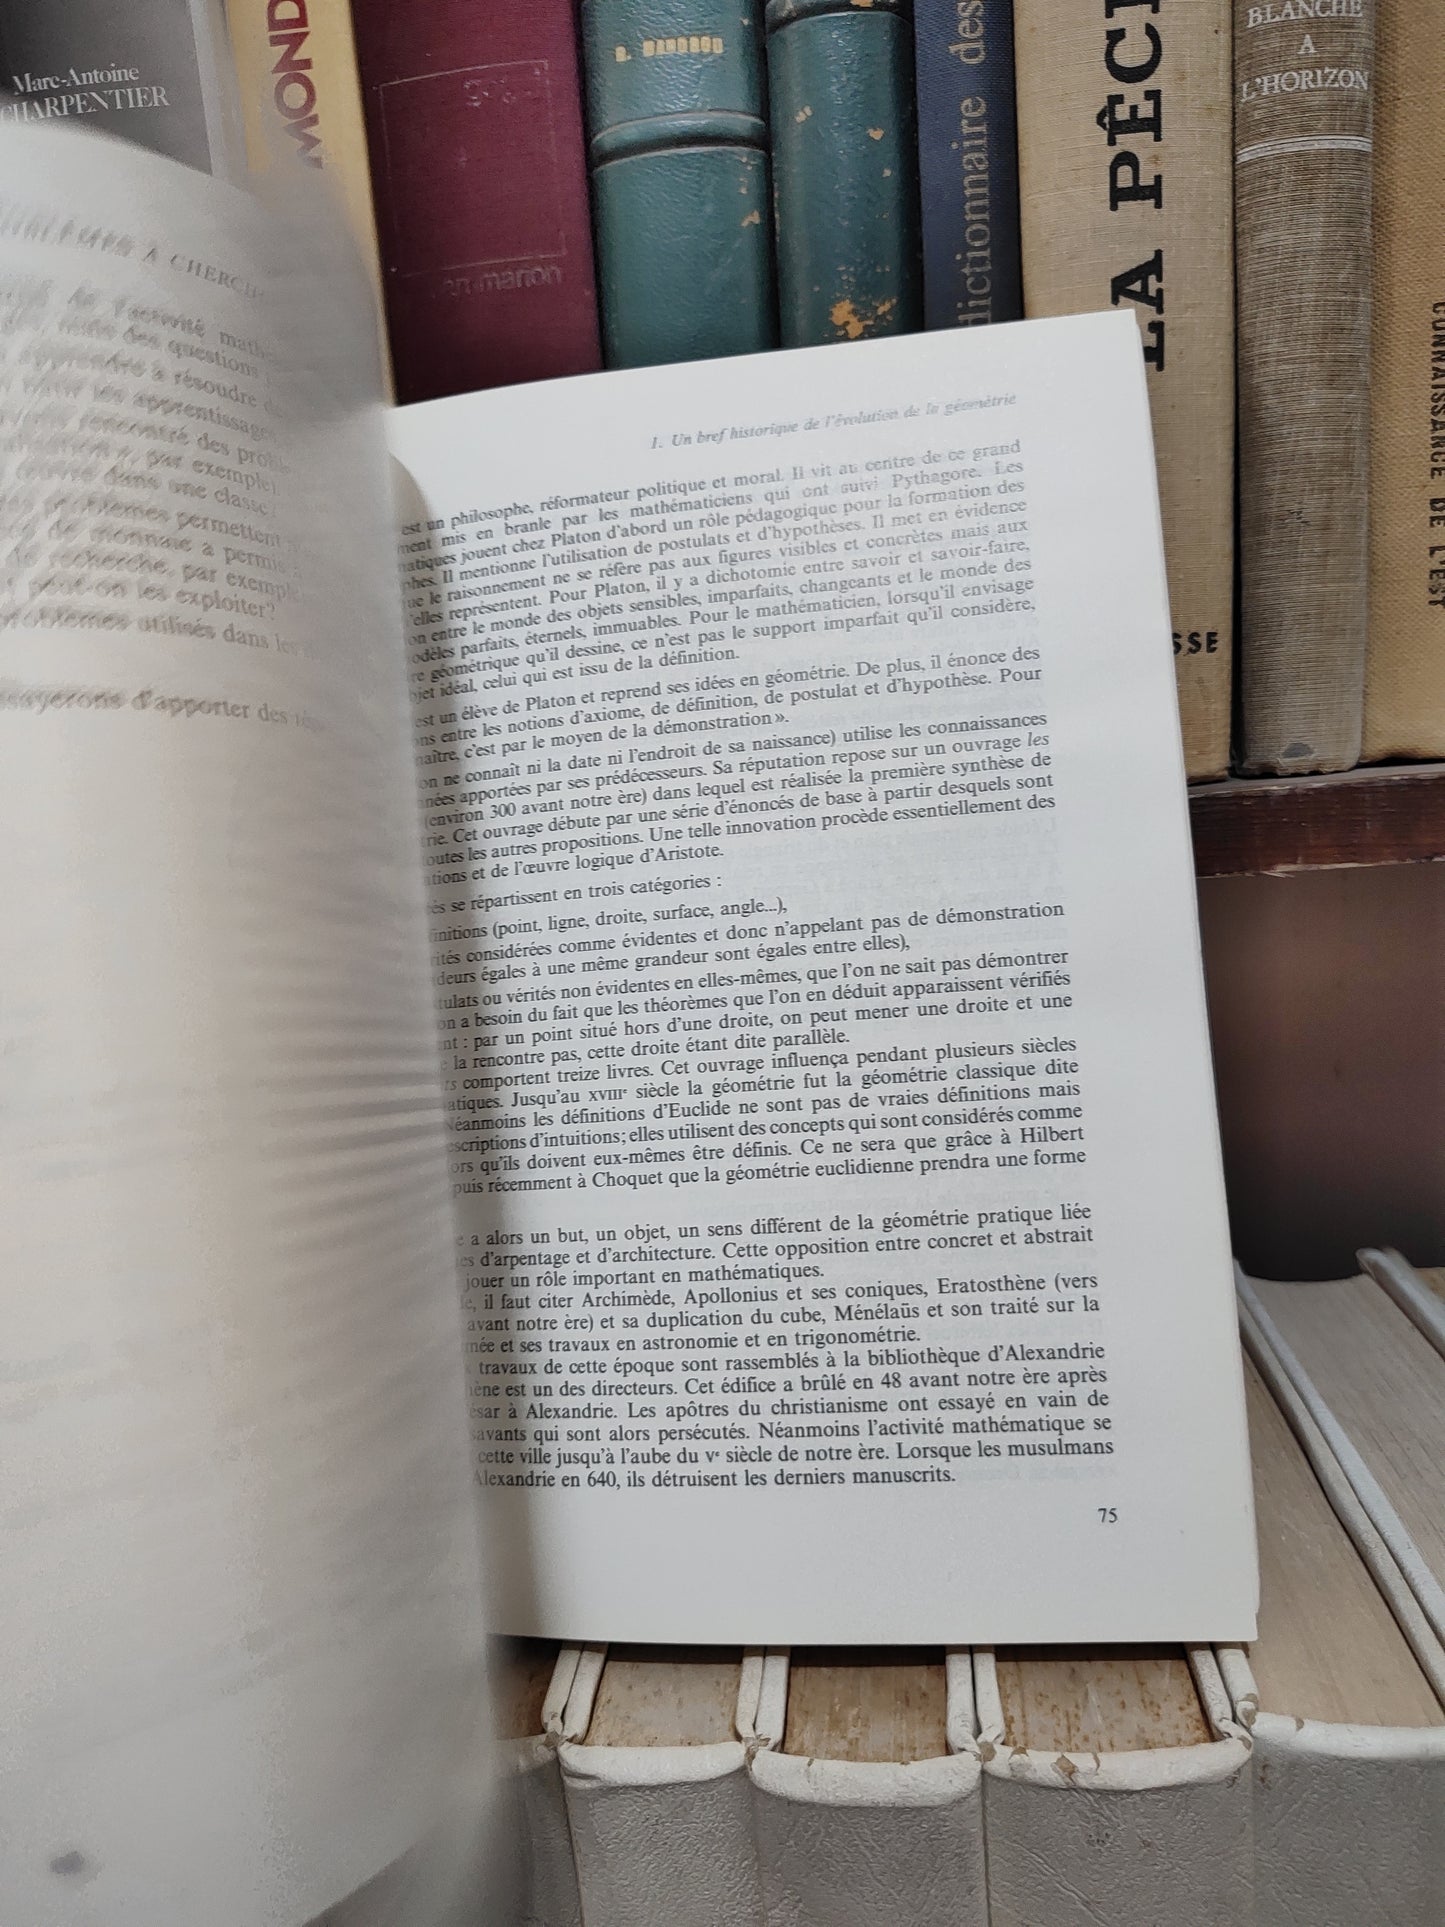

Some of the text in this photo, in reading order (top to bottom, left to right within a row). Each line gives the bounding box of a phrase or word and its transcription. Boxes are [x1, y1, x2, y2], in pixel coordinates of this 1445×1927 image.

[948, 0, 986, 65] des
[1247, 0, 1363, 28] BLANCHE
[1297, 34, 1319, 55] A
[13, 62, 140, 95] Marc-Antoine
[1241, 66, 1370, 103] L'HORIZON
[1097, 0, 1164, 212] PÊC
[222, 622, 270, 651] dans
[471, 865, 486, 882] et
[490, 861, 510, 880] de
[513, 858, 571, 877] l'œuvre
[575, 850, 635, 874] logique
[639, 843, 725, 864] d'Aristote.
[450, 899, 466, 912] se
[470, 886, 559, 913] répartissent
[563, 887, 584, 901] en
[587, 879, 625, 899] trois
[629, 872, 712, 897] catégories
[510, 1087, 581, 1111] Jusqu'au
[635, 1080, 680, 1100] siècle
[687, 1078, 704, 1096] la
[711, 1072, 796, 1099] géométrie
[803, 1071, 829, 1089] fut
[835, 1069, 853, 1087] la
[860, 1063, 948, 1090] géométrie
[955, 1060, 1037, 1082] classique
[1044, 1057, 1080, 1075] dite
[487, 1174, 573, 1193] récemment
[576, 1170, 588, 1189] à
[591, 1169, 664, 1191] Choquet
[668, 1171, 700, 1189] que
[704, 1164, 721, 1183] la
[725, 1160, 811, 1186] géométrie
[814, 1156, 915, 1177] euclidienne
[918, 1151, 991, 1176] prendra
[994, 1153, 1029, 1167] une
[1033, 1147, 1087, 1165] forme
[470, 1202, 1092, 1247] a alors un but, un objet, un sens différent de la géométrie pratique liée
[484, 1270, 1099, 1311] il faut citer Archimède, Apollonius et ses coniques, Eratosthène (vers
[478, 1341, 1106, 1378] travaux de cette époque sont rassemblés à la bibliothèque d'Alexandrie
[504, 1382, 527, 1398] est
[532, 1385, 554, 1398] un
[558, 1379, 586, 1397] des
[591, 1378, 678, 1396] directeurs.
[684, 1376, 716, 1394] Cet
[720, 1375, 777, 1394] édifice
[782, 1379, 795, 1392] a
[800, 1372, 847, 1392] brûlé
[852, 1377, 875, 1390] en
[879, 1371, 903, 1389] 48
[908, 1371, 961, 1388] avant
[966, 1370, 1016, 1386] notre
[1022, 1366, 1051, 1384] ère
[1057, 1364, 1108, 1387] après
[560, 1475, 581, 1487] en
[586, 1469, 622, 1490] 640,
[626, 1469, 646, 1487] ils
[651, 1469, 739, 1487] détruisent
[743, 1468, 768, 1486] les
[773, 1467, 846, 1486] derniers
[851, 1464, 957, 1484] manuscrits.
[1097, 1507, 1119, 1525] 75
